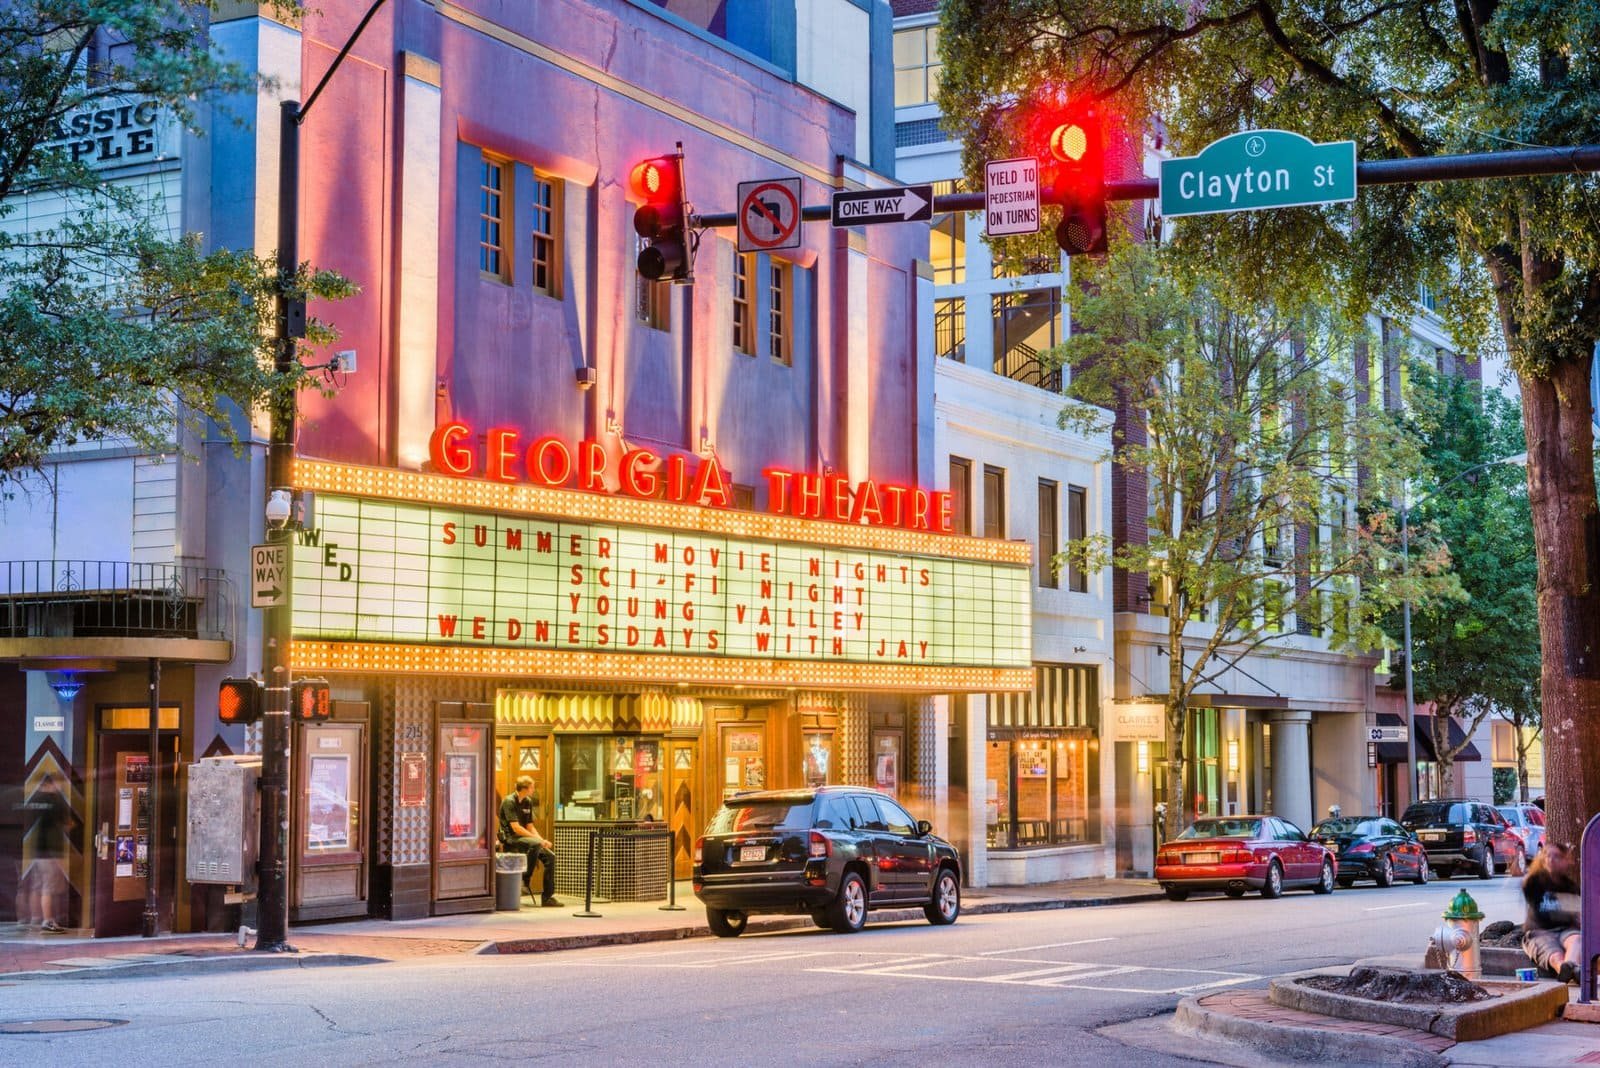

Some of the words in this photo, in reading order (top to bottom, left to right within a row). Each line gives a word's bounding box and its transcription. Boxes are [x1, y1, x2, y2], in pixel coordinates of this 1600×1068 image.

[990, 169, 1017, 186] YIELD
[1023, 168, 1035, 182] TO
[1179, 166, 1290, 203] Clayton
[1313, 165, 1335, 187] St
[842, 201, 869, 216] ONE
[874, 198, 902, 214] WAY
[990, 190, 1035, 204] PEDESTRIAN
[990, 211, 1003, 226] ON
[1006, 208, 1036, 224] TURNS
[429, 422, 735, 509] GEORGIA
[763, 467, 954, 532] THEATRE
[256, 549, 284, 566] ONE
[443, 523, 611, 559] SUMMER
[655, 543, 770, 573] MOVIE
[809, 558, 930, 587] NIGHTS
[256, 567, 285, 583] WAY
[760, 579, 864, 605] NIGHT
[569, 592, 694, 622] YOUNG
[736, 604, 863, 630] VALLEY
[438, 615, 719, 650] WEDNESDAYS
[756, 632, 842, 655] WITH
[876, 638, 928, 659] JAY
